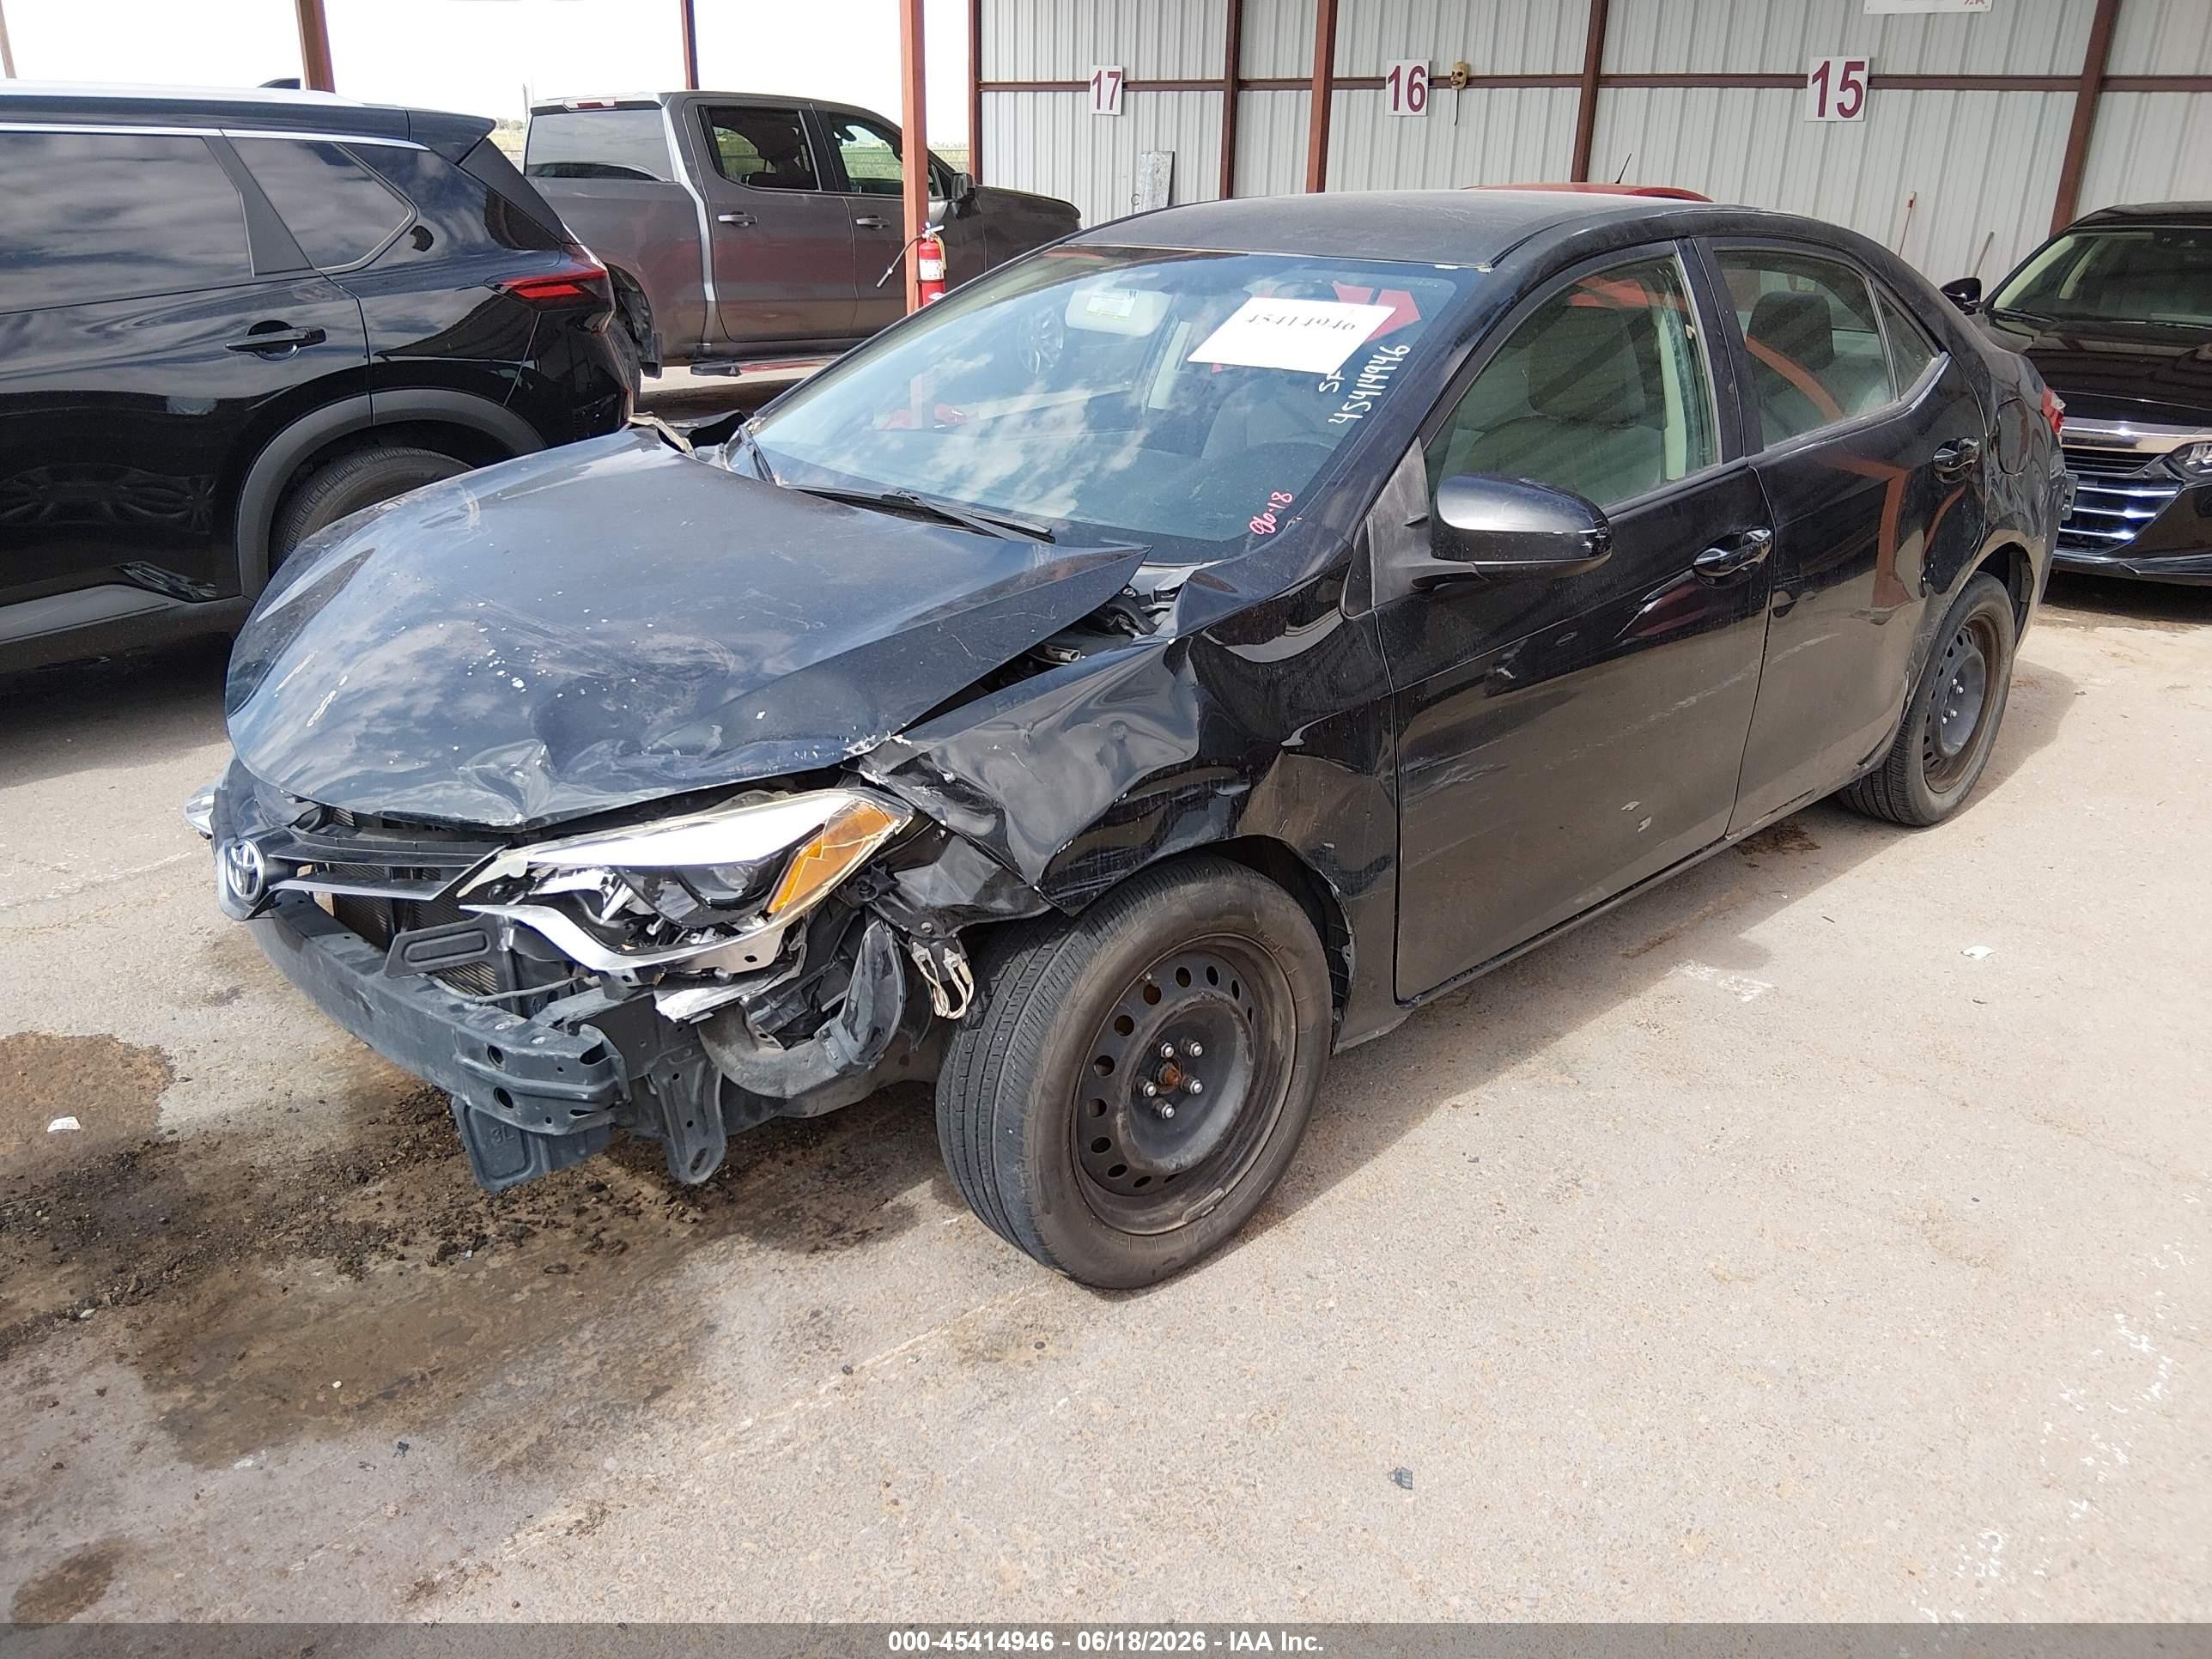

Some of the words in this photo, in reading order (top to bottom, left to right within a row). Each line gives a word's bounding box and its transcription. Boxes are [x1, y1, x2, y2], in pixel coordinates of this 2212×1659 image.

[1092, 70, 1121, 110] 17
[1387, 65, 1426, 112] 16
[1811, 60, 1866, 118] 15
[1328, 345, 1411, 424] 45414946
